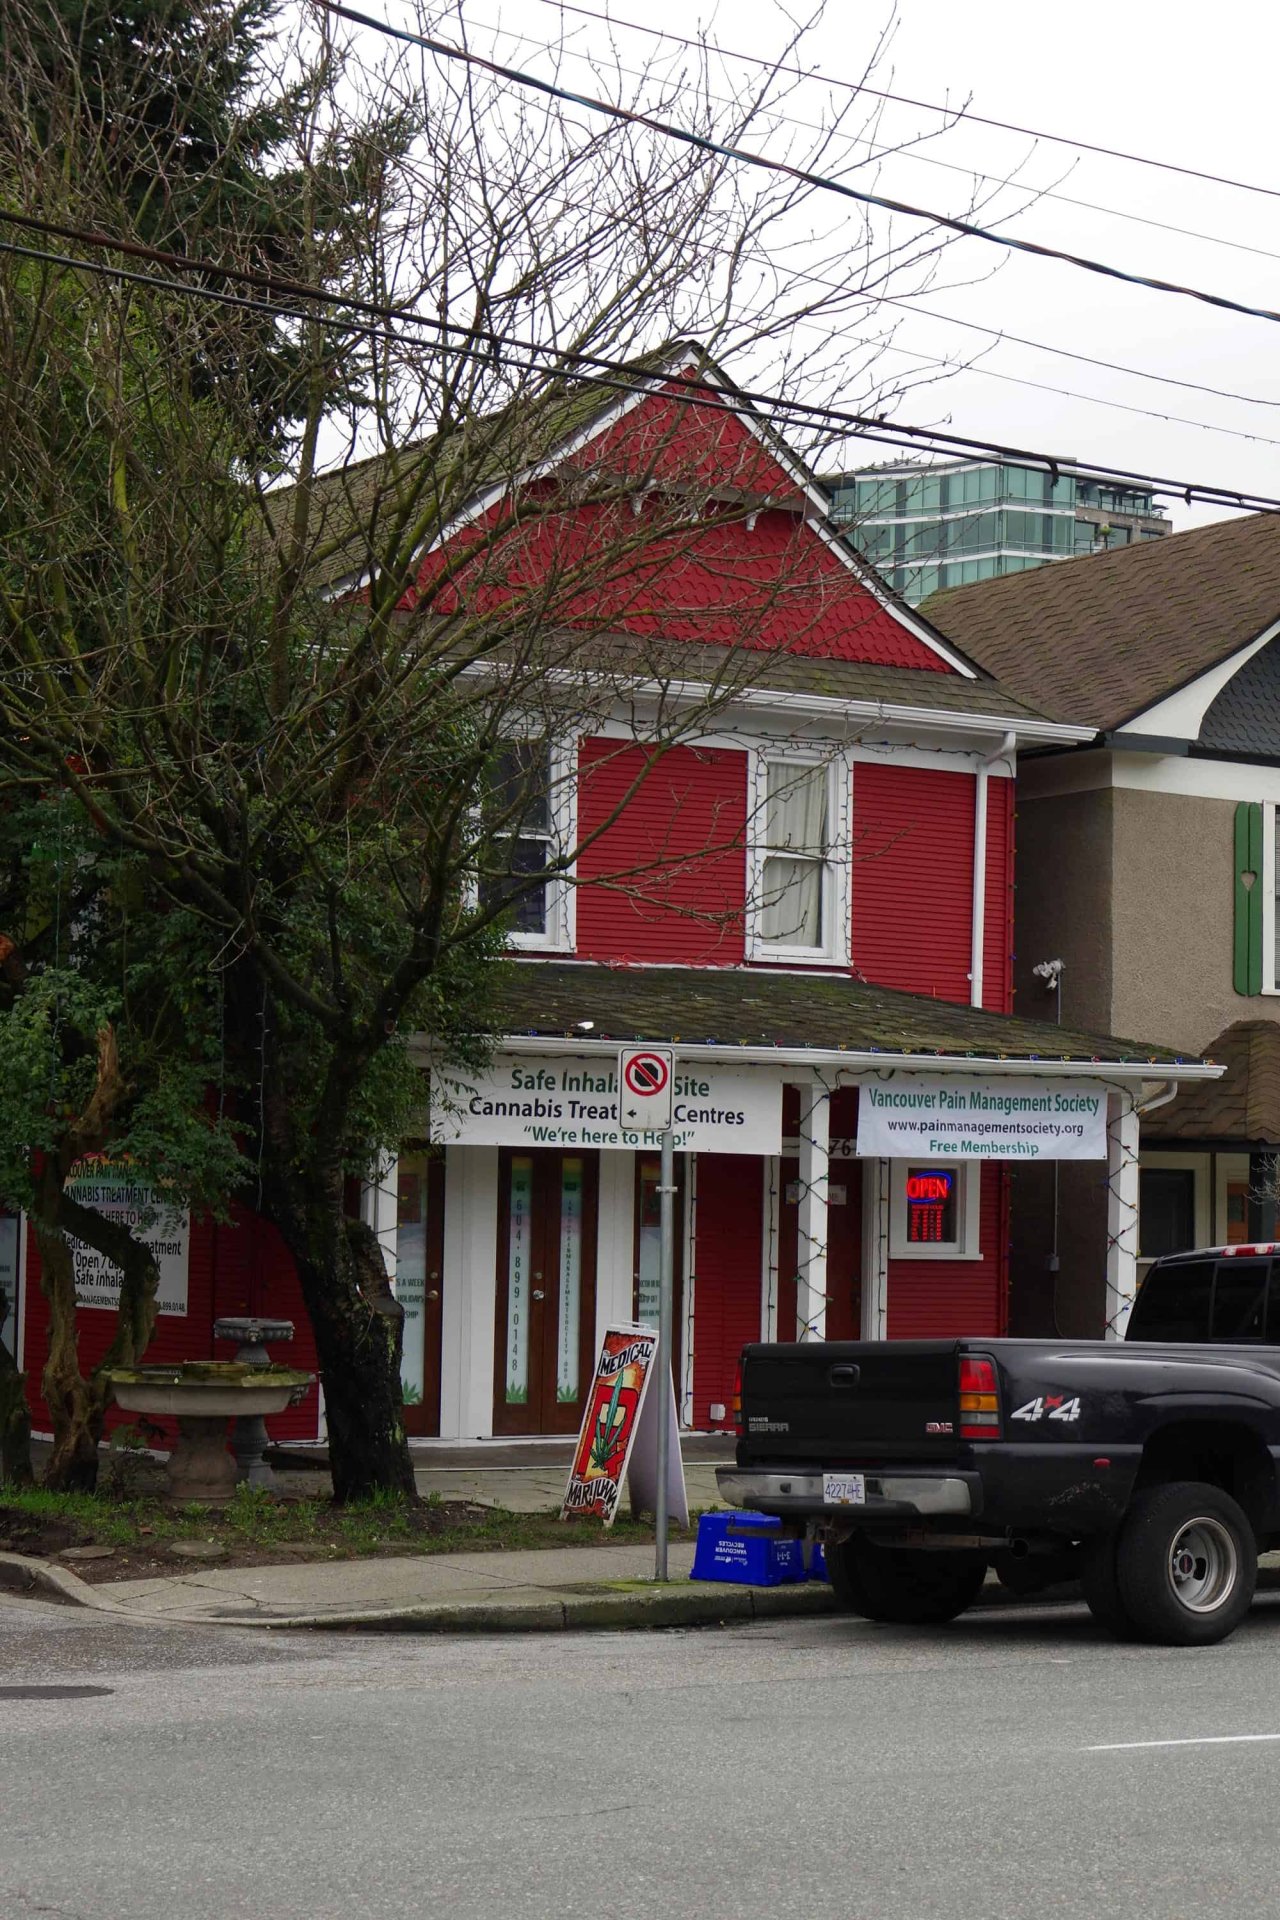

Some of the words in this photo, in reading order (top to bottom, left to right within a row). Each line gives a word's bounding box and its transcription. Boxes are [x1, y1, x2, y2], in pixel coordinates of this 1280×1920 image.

[511, 1069, 556, 1091] Safe
[674, 1076, 710, 1097] Site
[469, 1096, 562, 1118] Cannabis
[568, 1101, 617, 1120] Treat
[674, 1105, 745, 1125] Centres
[869, 1088, 936, 1108] Vancouver
[939, 1090, 966, 1109] Pain
[970, 1092, 1051, 1115] Management
[1054, 1093, 1099, 1117] Society
[888, 1119, 1084, 1137] www.painmanagementsociety.org
[582, 1127, 618, 1143] here
[622, 1131, 639, 1144] to
[644, 1131, 695, 1149] Hep!"
[930, 1140, 958, 1152] Free
[961, 1141, 1039, 1156] Membership
[65, 1185, 99, 1202] ANNABIS
[906, 1177, 948, 1199] OPEN
[76, 1252, 99, 1271] Open
[75, 1269, 94, 1286] Safe
[600, 1342, 651, 1375] MEDICAL
[748, 1422, 790, 1432] SIERRA
[926, 1422, 953, 1433] GMC
[567, 1479, 617, 1508] MARIJUANA
[825, 1483, 847, 1498] 4227
